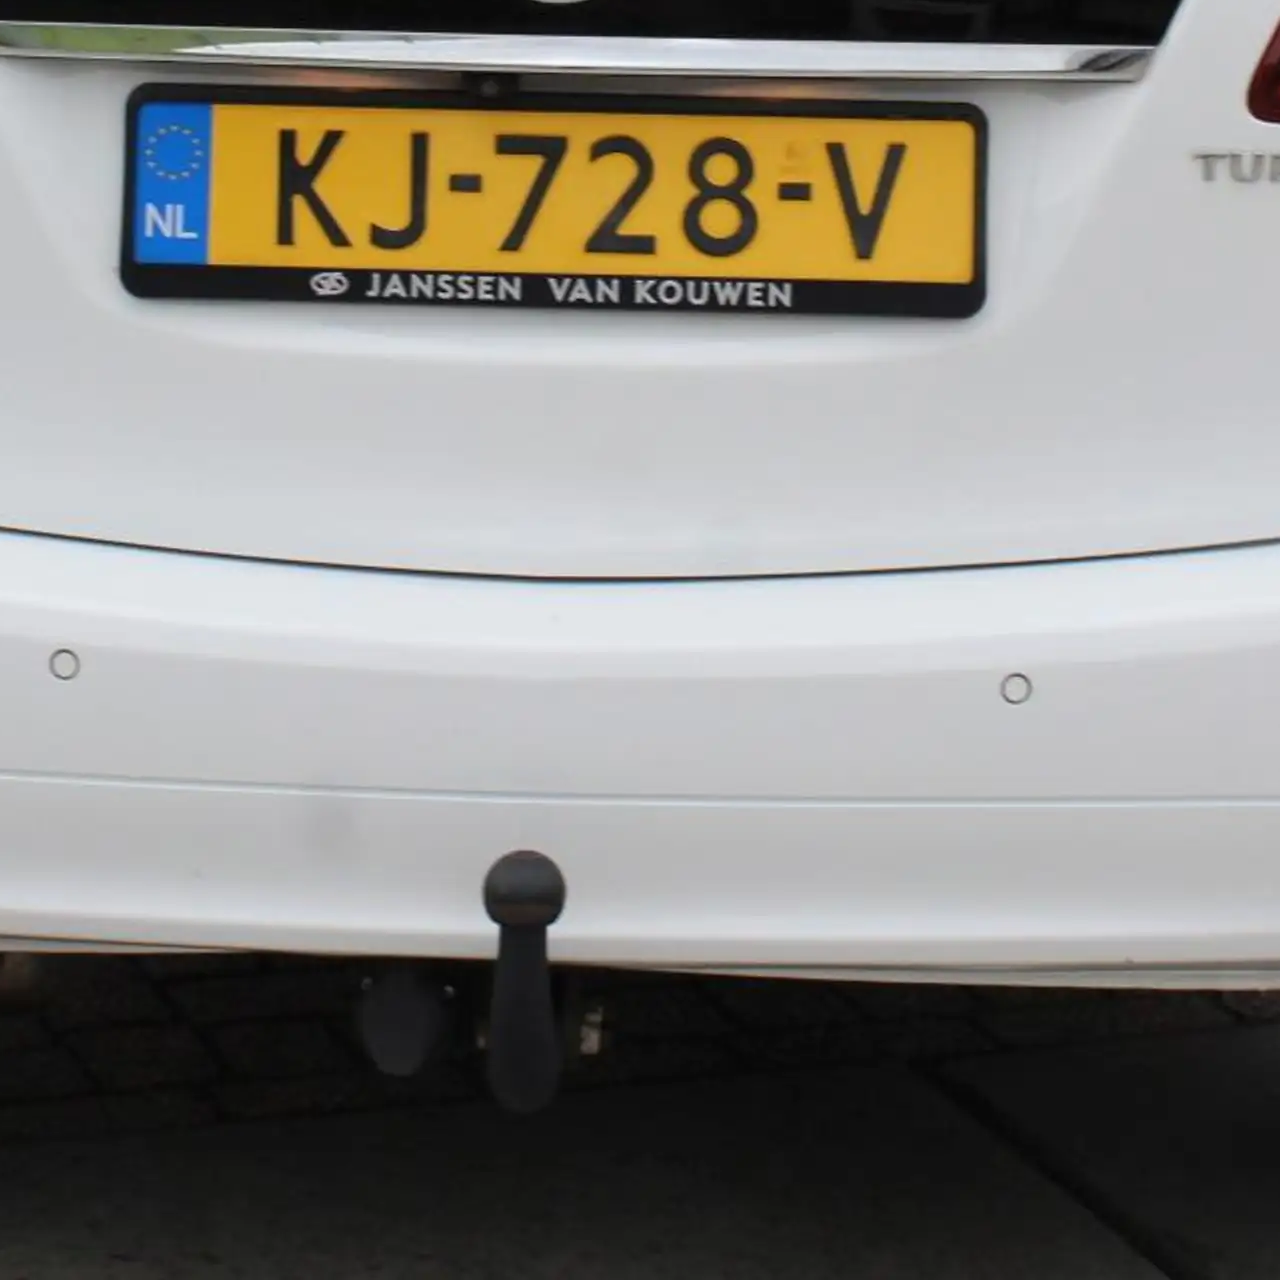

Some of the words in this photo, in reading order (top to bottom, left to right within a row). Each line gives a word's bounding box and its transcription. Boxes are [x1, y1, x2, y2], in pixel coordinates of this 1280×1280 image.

[275, 128, 907, 261] KJ-728-V
[144, 202, 198, 241] NL
[365, 272, 523, 302] JANSSEN
[547, 277, 620, 304] VAN
[634, 279, 793, 308] KOUWEN
